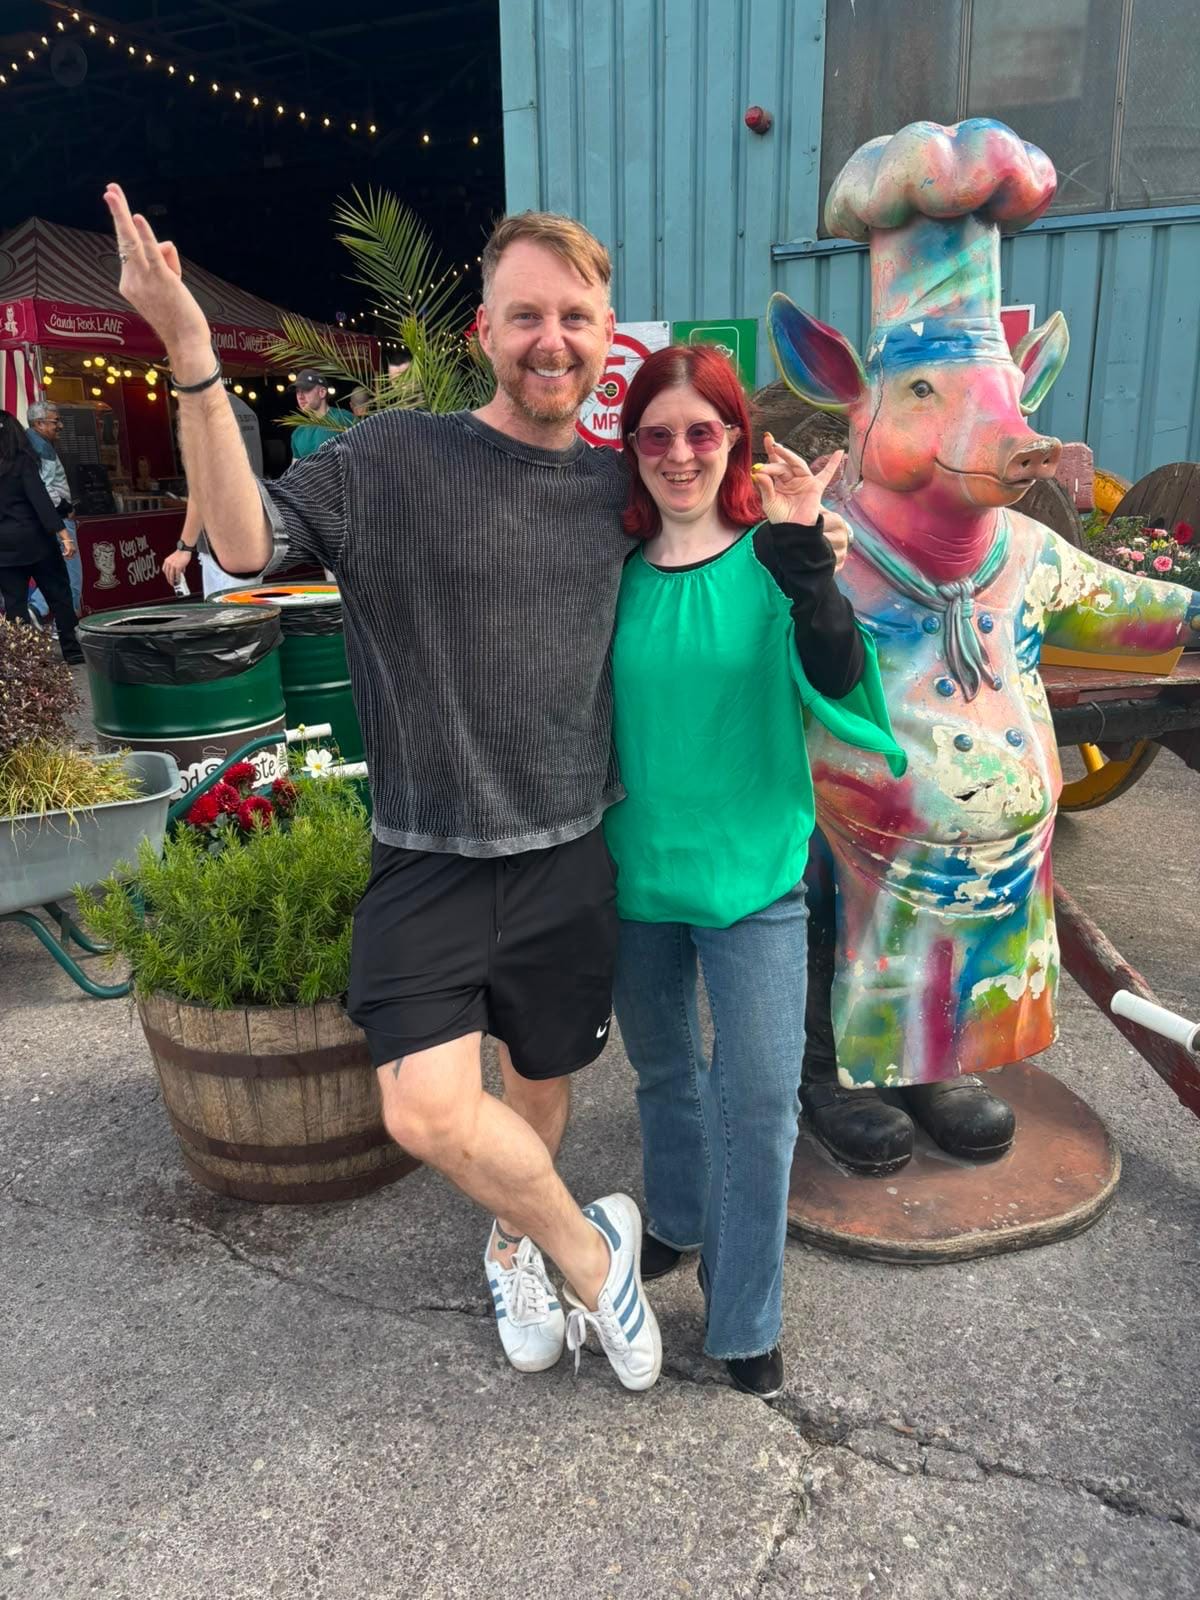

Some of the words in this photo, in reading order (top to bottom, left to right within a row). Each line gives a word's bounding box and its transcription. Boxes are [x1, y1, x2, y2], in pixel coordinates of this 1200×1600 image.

[50, 313, 75, 334] Candy
[76, 317, 97, 331] Rock
[97, 317, 124, 334] LANE
[213, 328, 237, 350] ional
[596, 356, 628, 408] 5
[593, 413, 620, 430] MP
[119, 540, 137, 558] Keep
[180, 769, 199, 793] od
